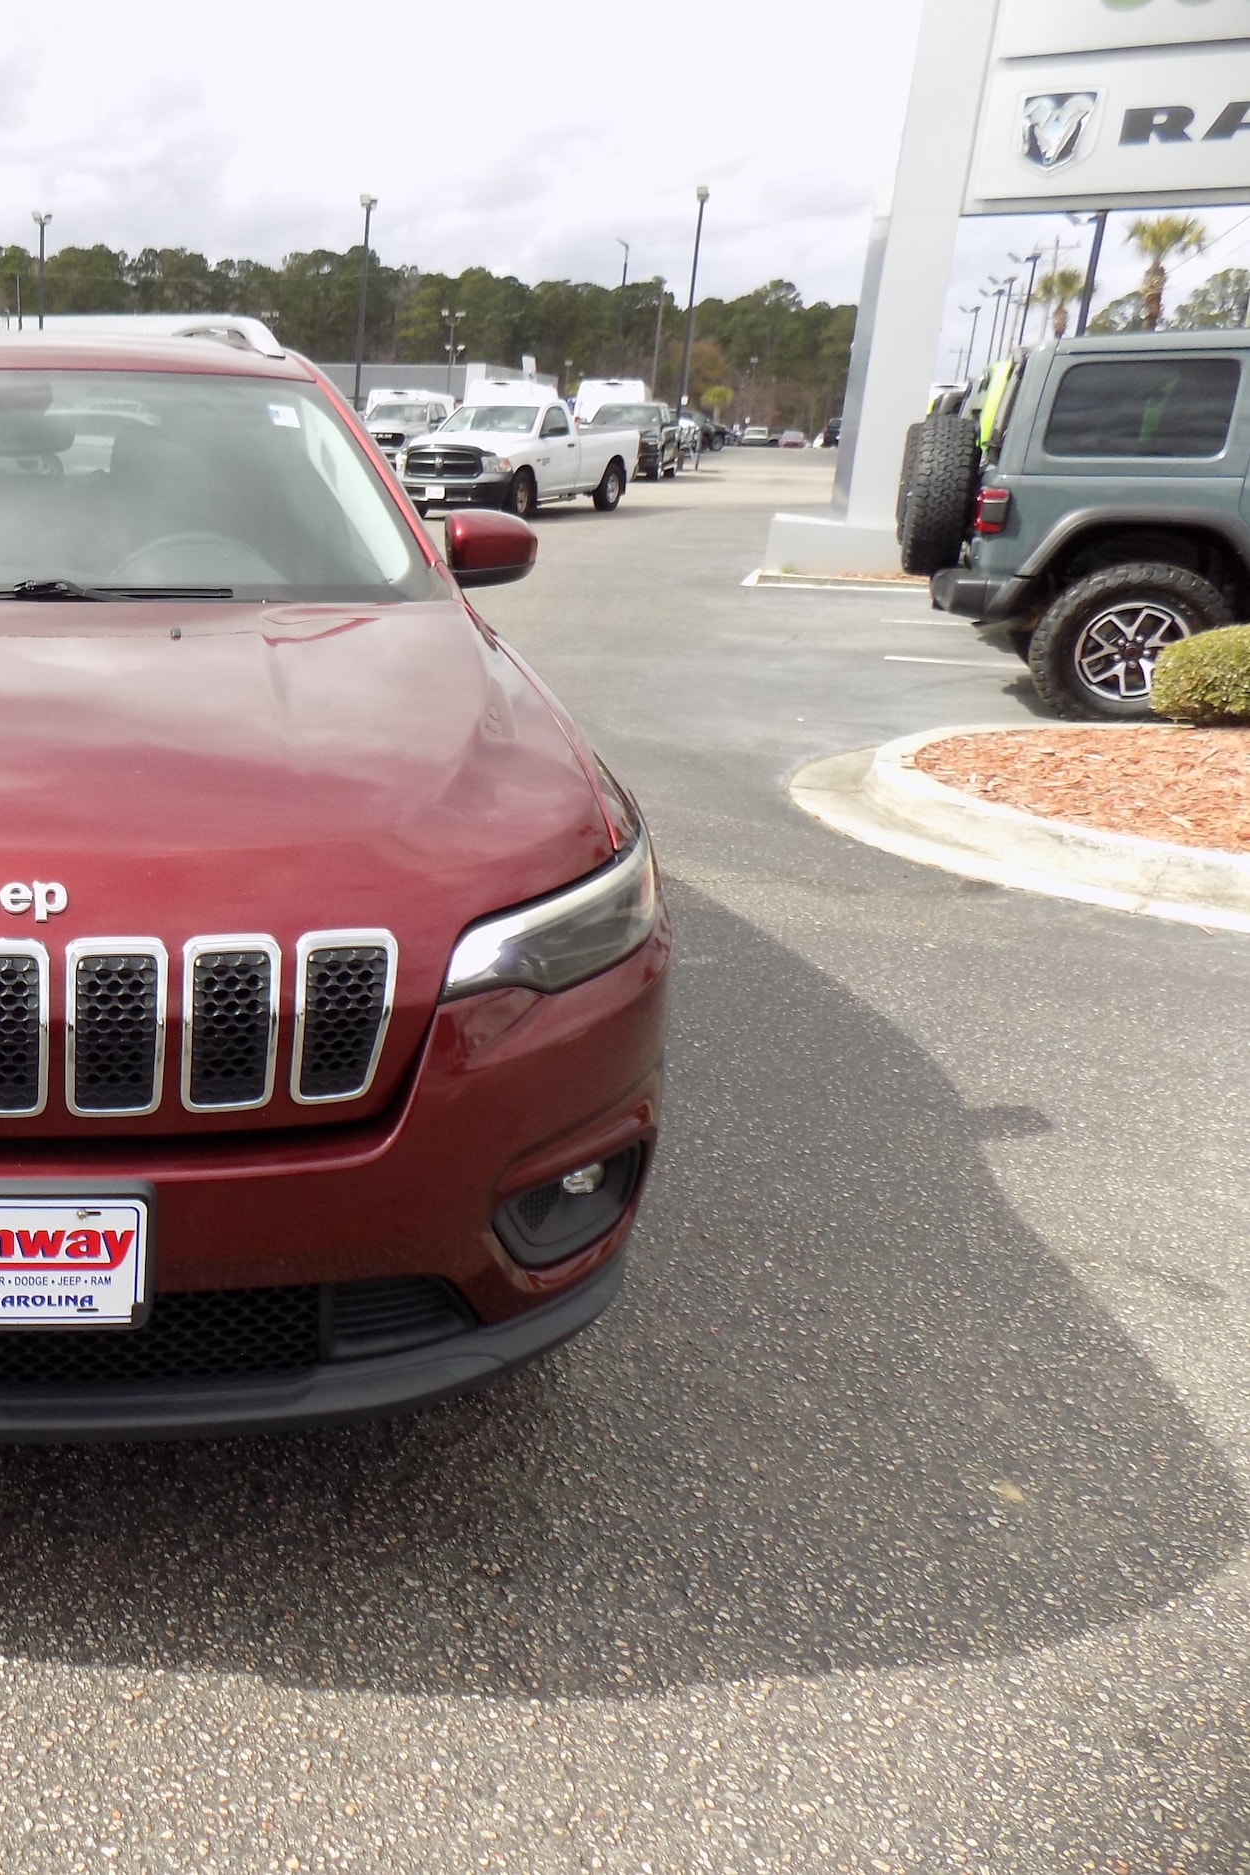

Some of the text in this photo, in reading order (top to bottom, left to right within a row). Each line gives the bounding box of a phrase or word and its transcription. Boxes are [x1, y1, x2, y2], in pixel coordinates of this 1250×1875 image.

[14, 1275, 49, 1286] DODGE
[57, 1275, 82, 1286] JEEP
[90, 1275, 112, 1286] RAM
